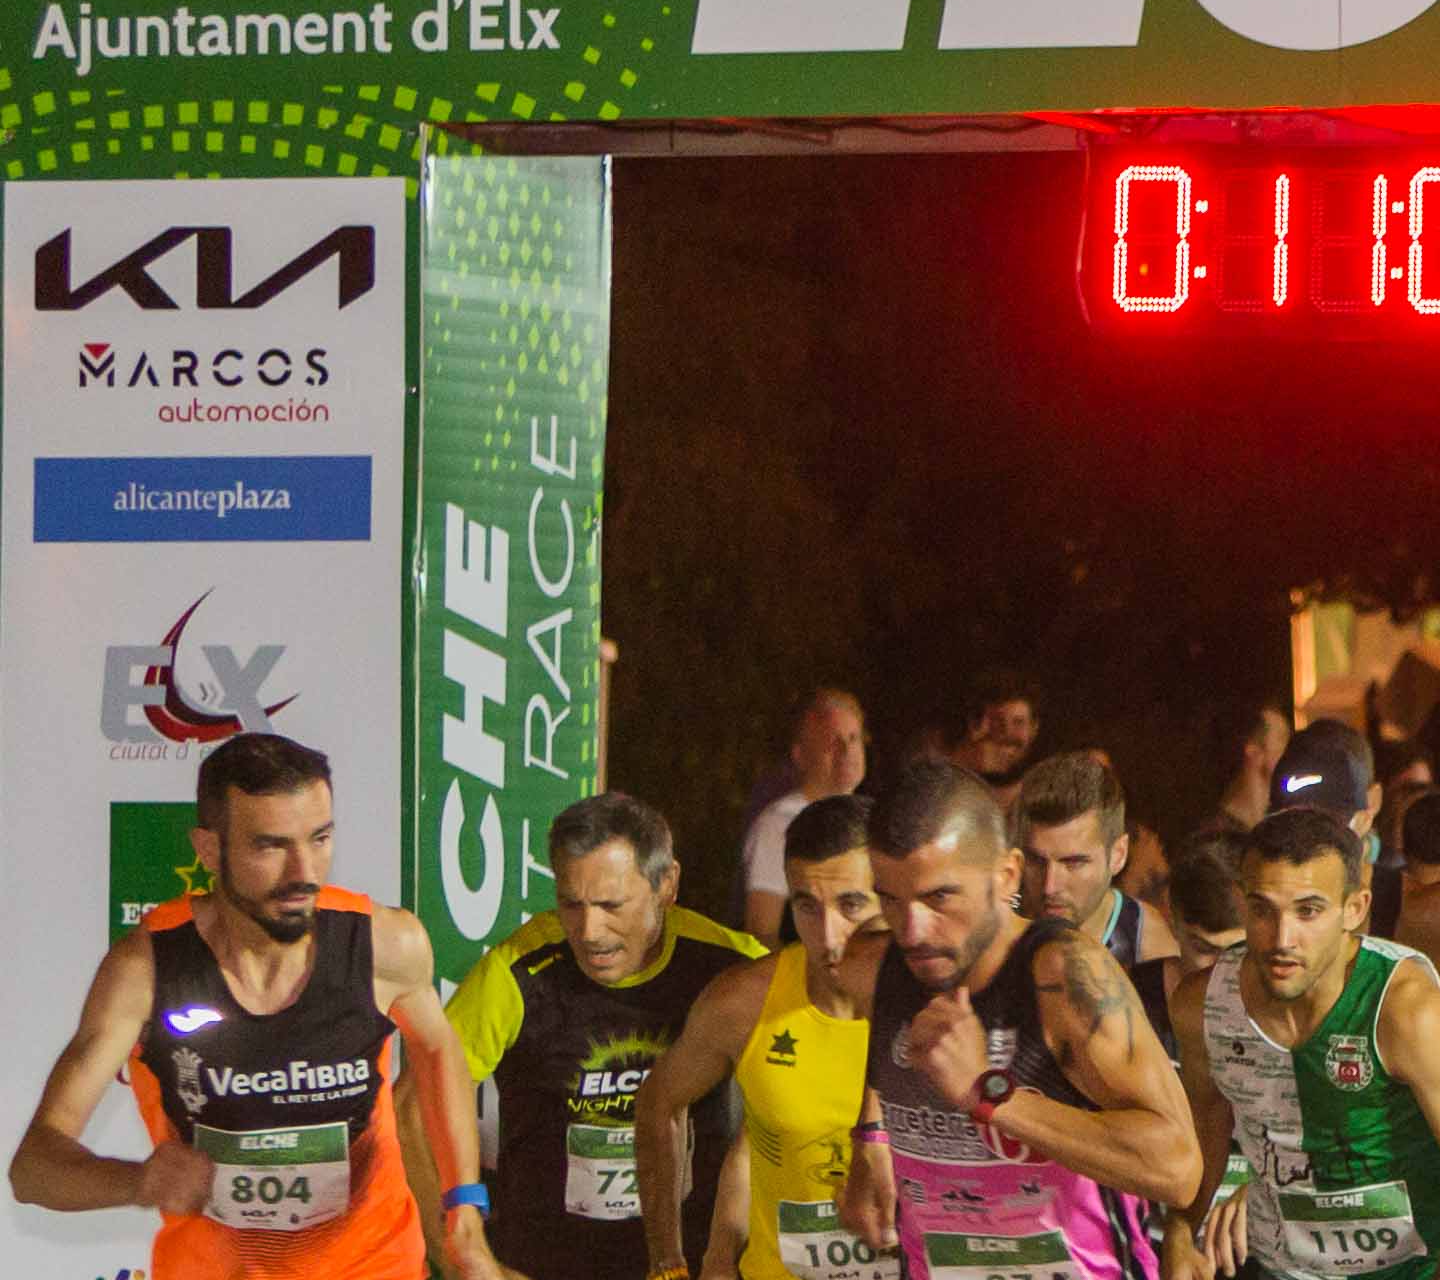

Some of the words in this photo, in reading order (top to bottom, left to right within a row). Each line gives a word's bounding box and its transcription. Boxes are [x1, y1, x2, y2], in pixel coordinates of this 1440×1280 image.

[33, 0, 392, 76] Ajuntament
[34, 225, 377, 311] KIA
[79, 344, 330, 389] MARCOS
[157, 396, 331, 423] automoción
[112, 480, 291, 518] alicanteplaza
[524, 414, 578, 780] RACE
[581, 1068, 652, 1097] ELC
[239, 1133, 299, 1150] ELCHE
[230, 1174, 313, 1204] 804
[1315, 1193, 1364, 1209] ELCHE
[1308, 1226, 1400, 1255] 1109
